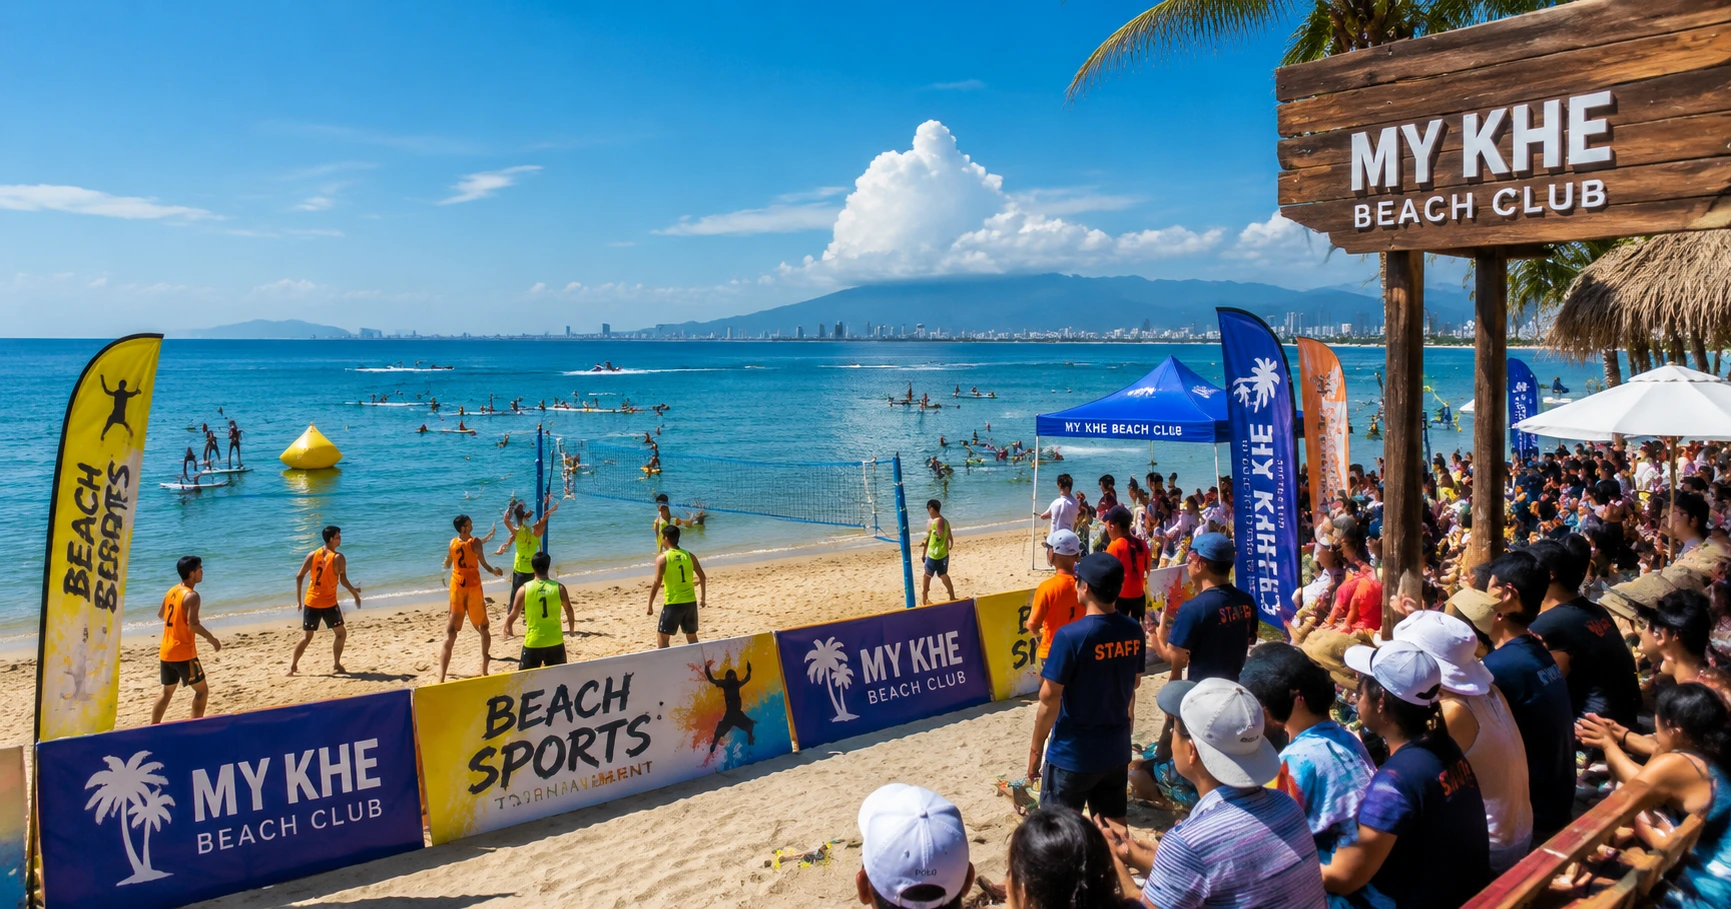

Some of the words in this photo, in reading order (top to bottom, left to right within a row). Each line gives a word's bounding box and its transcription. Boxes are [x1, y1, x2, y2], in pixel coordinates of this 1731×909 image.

[1350, 118, 1444, 192] MY
[1462, 90, 1613, 178] KHE
[1353, 192, 1474, 229] BEACH
[1491, 179, 1607, 217] CLUB
[1065, 421, 1081, 433] MY
[1085, 422, 1108, 434] KHE
[1111, 423, 1149, 436] BEACH
[62, 462, 102, 603] BEACH
[315, 566, 324, 587] 2
[678, 564, 686, 583] 1
[166, 603, 175, 628] 2
[538, 596, 549, 619] 1
[860, 642, 902, 684] MY
[909, 630, 964, 674] KHE
[481, 671, 635, 740] BEACH
[867, 679, 922, 705] BEACH
[927, 670, 967, 691] CLUB
[467, 712, 652, 795] SPORTS
[192, 757, 271, 823] MY
[284, 738, 382, 805] KHE
[197, 814, 298, 855] BEACH
[310, 798, 383, 830] CLUB
